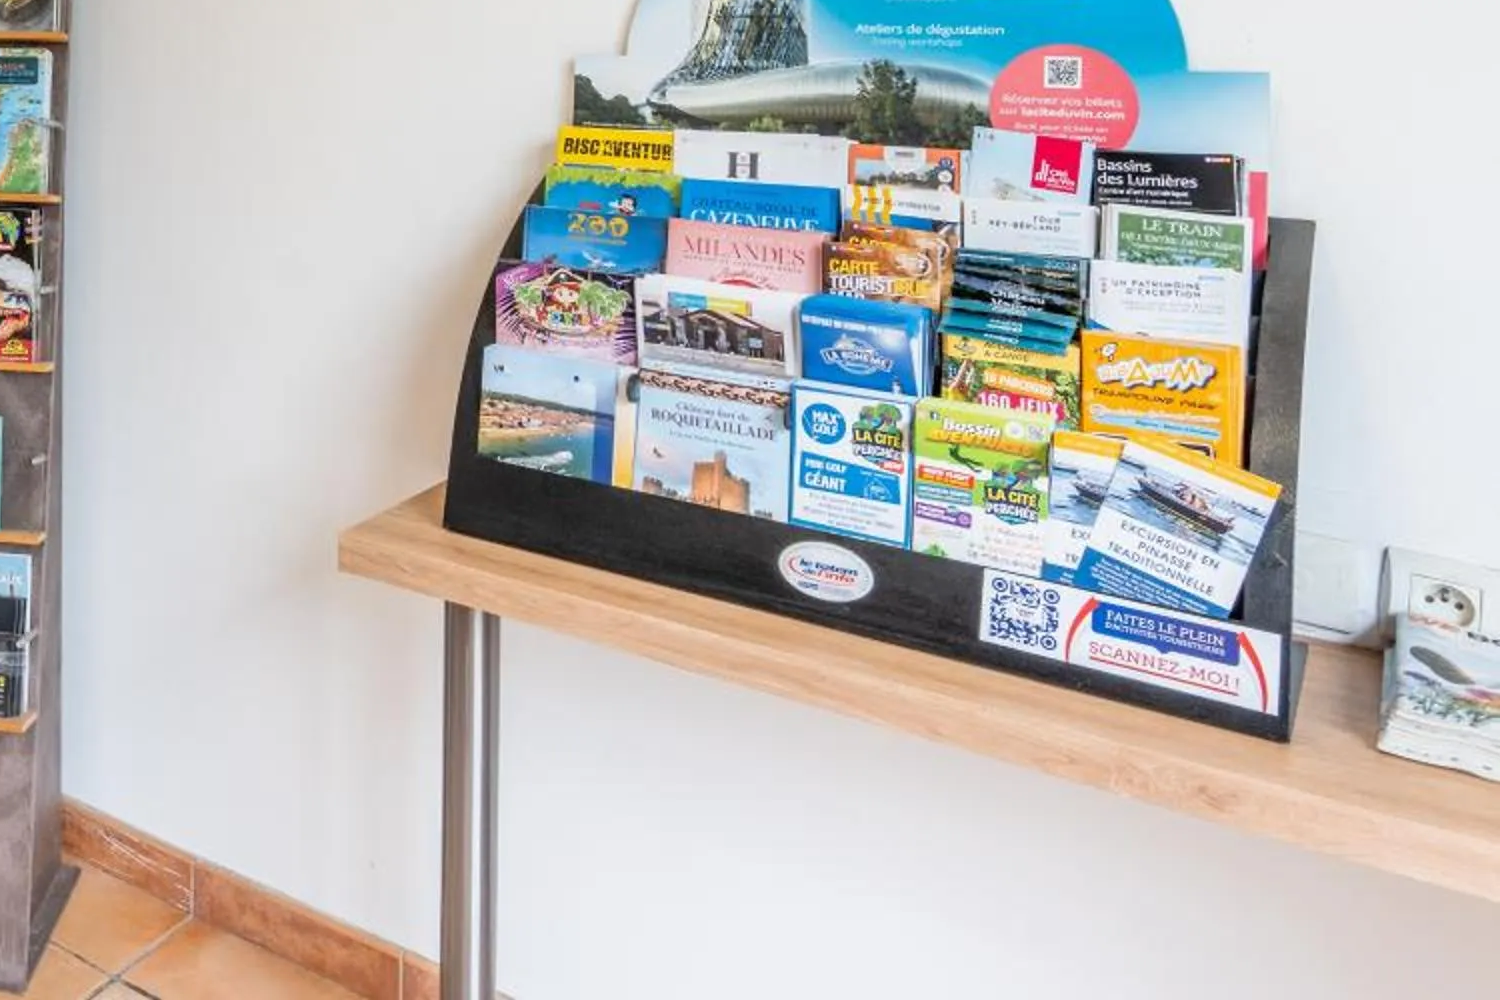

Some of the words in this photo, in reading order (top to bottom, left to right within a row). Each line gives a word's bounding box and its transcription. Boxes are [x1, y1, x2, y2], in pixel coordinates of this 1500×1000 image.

[854, 24, 903, 35] Ateliers
[907, 24, 922, 34] de
[926, 24, 1004, 38] dégustation
[1021, 107, 1125, 120] laciteduvin.com
[727, 152, 760, 179] H
[1098, 159, 1152, 173] Bassins
[1097, 172, 1123, 185] des
[1128, 174, 1199, 189] Lumières
[1142, 218, 1163, 232] LE
[1166, 221, 1223, 237] TRAIN
[829, 258, 879, 275] CARTE
[651, 408, 777, 441] ROQUETAILLADE
[855, 430, 872, 442] LA
[826, 461, 848, 472] GOLF
[805, 471, 846, 492] GÉANT
[988, 487, 1006, 501] LA
[1121, 521, 1198, 560] EXCURSION
[1202, 555, 1220, 569] EN
[1138, 542, 1191, 571] PINASSE
[1108, 541, 1214, 596] TRADITIONNELLE
[1106, 610, 1155, 629] FAITES
[1158, 621, 1178, 635] LE
[1180, 627, 1224, 646] PLEIN
